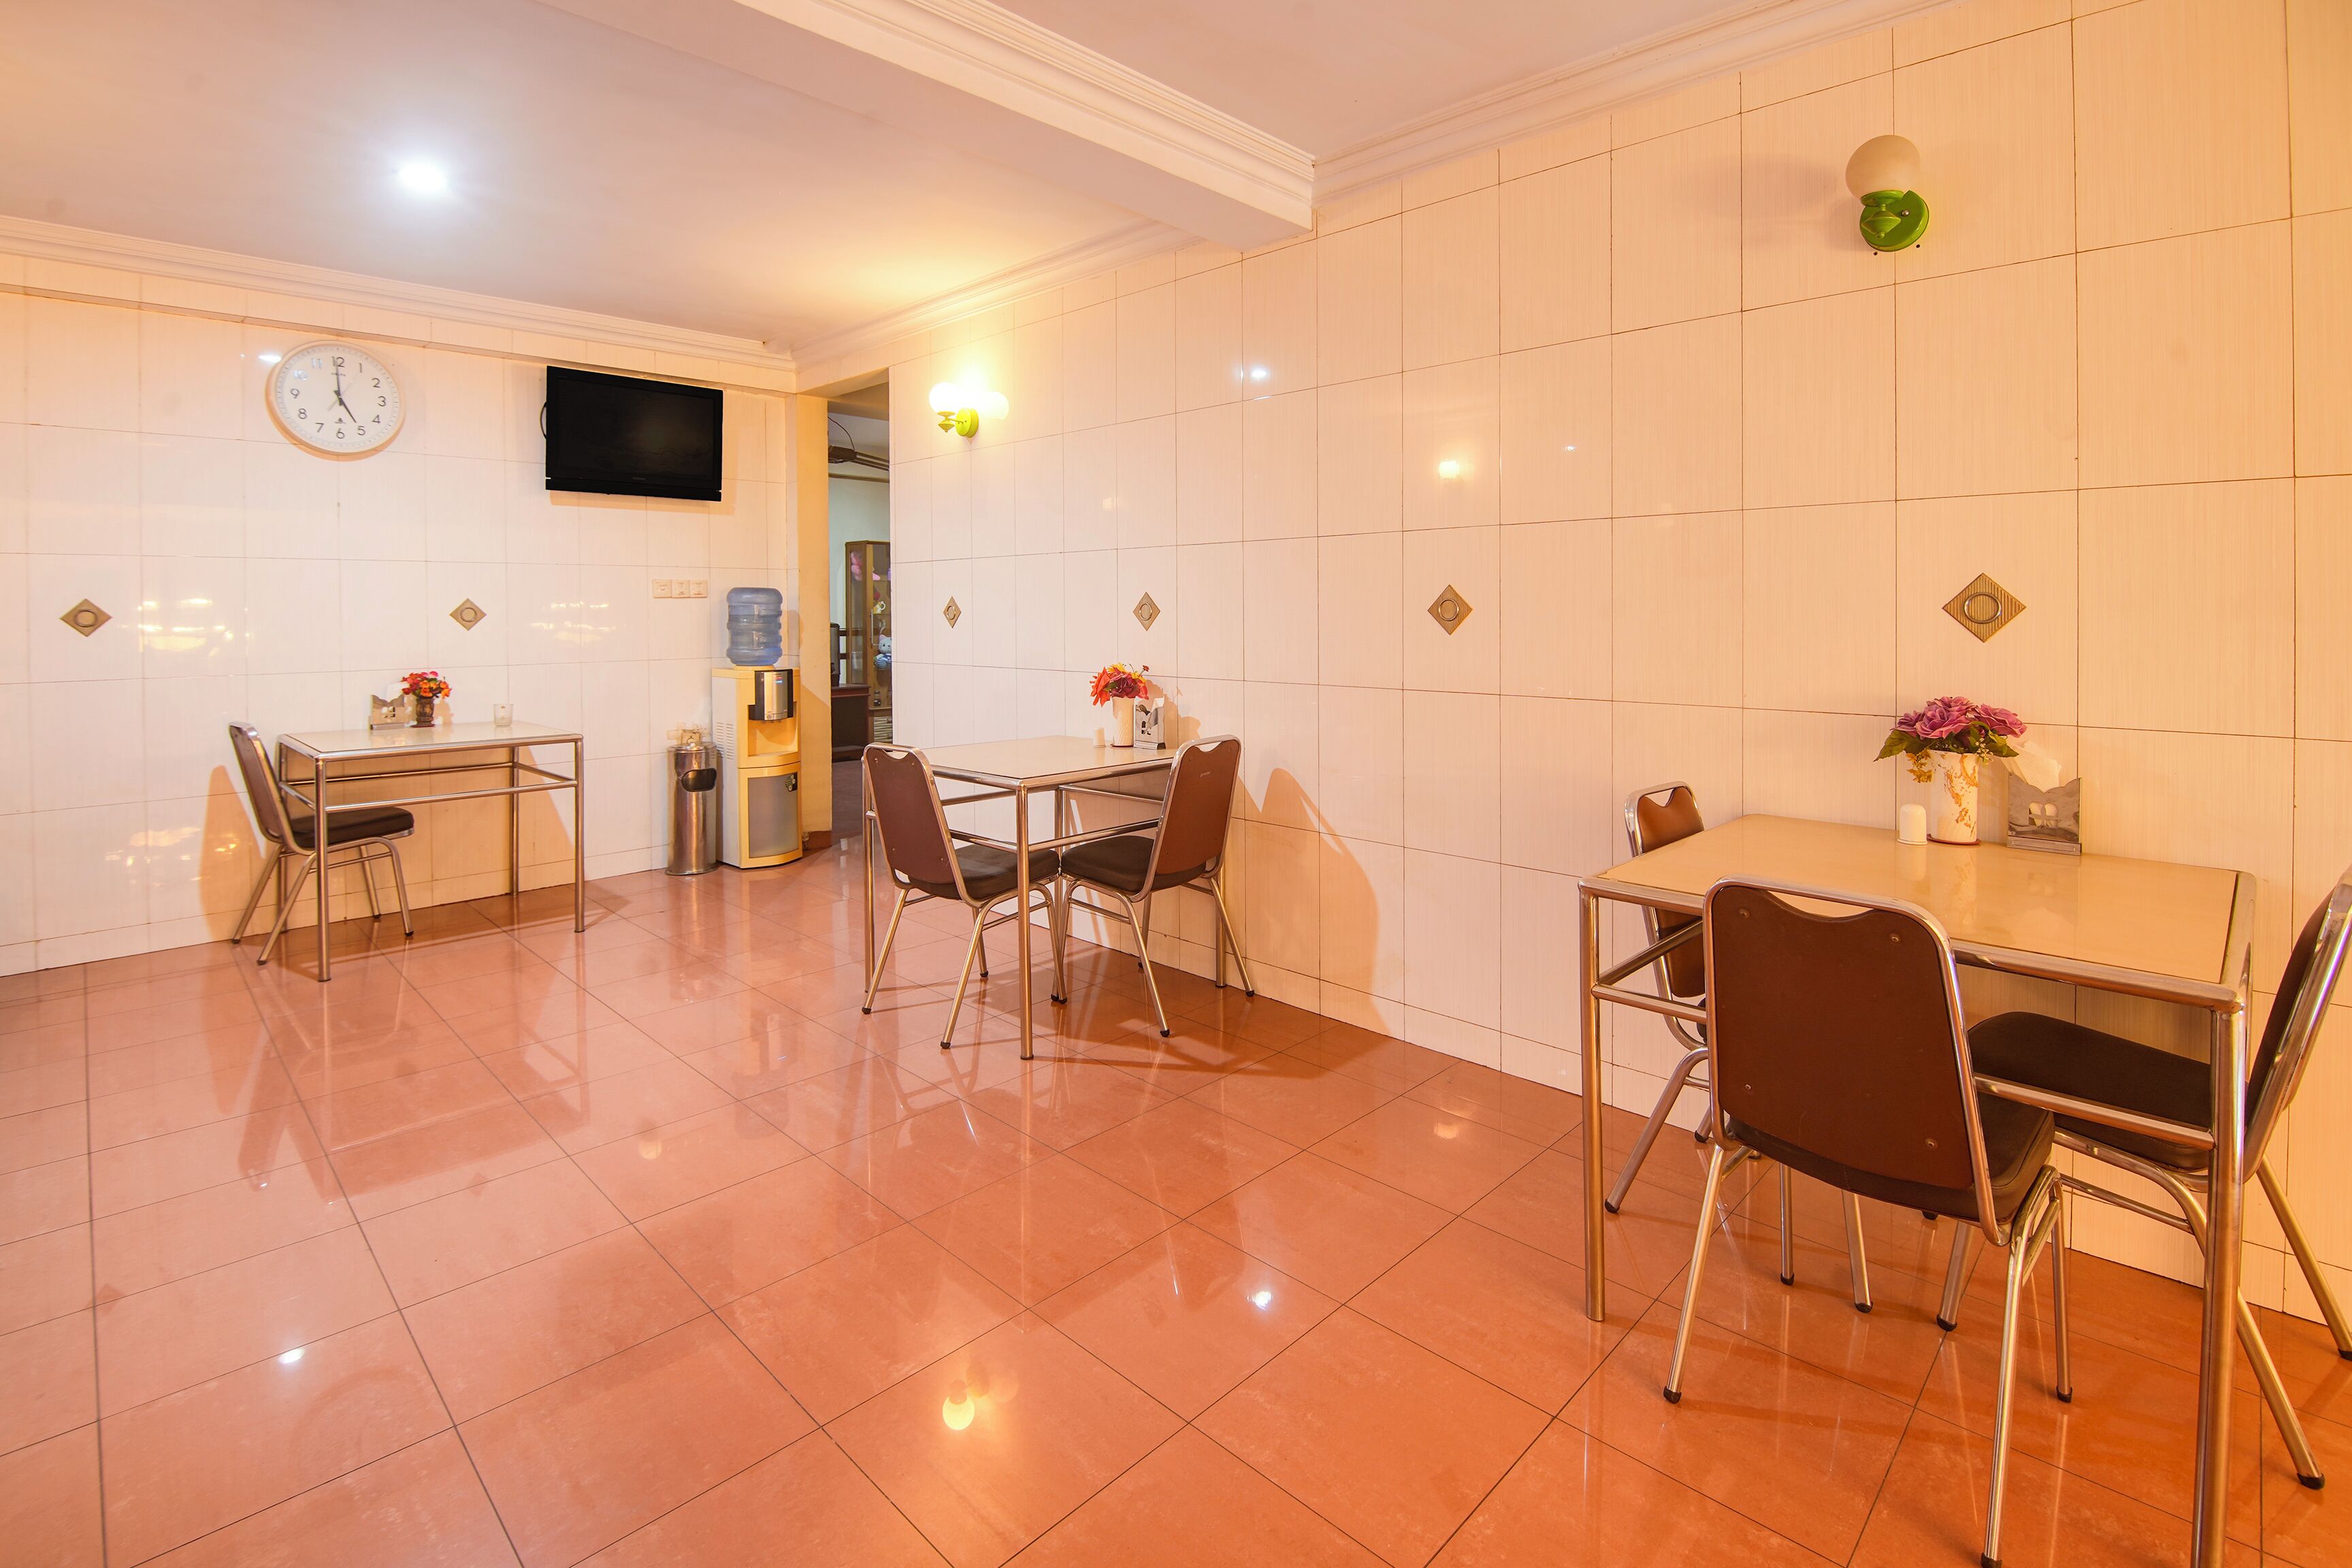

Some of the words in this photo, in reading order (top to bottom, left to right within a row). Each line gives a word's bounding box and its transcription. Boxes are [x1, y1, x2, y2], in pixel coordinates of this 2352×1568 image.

[331, 356, 345, 368] 12
[359, 363, 363, 373] 1
[372, 377, 380, 388] 2
[290, 388, 300, 399] 9
[378, 395, 387, 407] 3
[298, 408, 308, 419] 8
[372, 414, 381, 424] 4
[315, 422, 325, 433] 7
[357, 425, 366, 436] 5
[336, 428, 345, 439] 6
